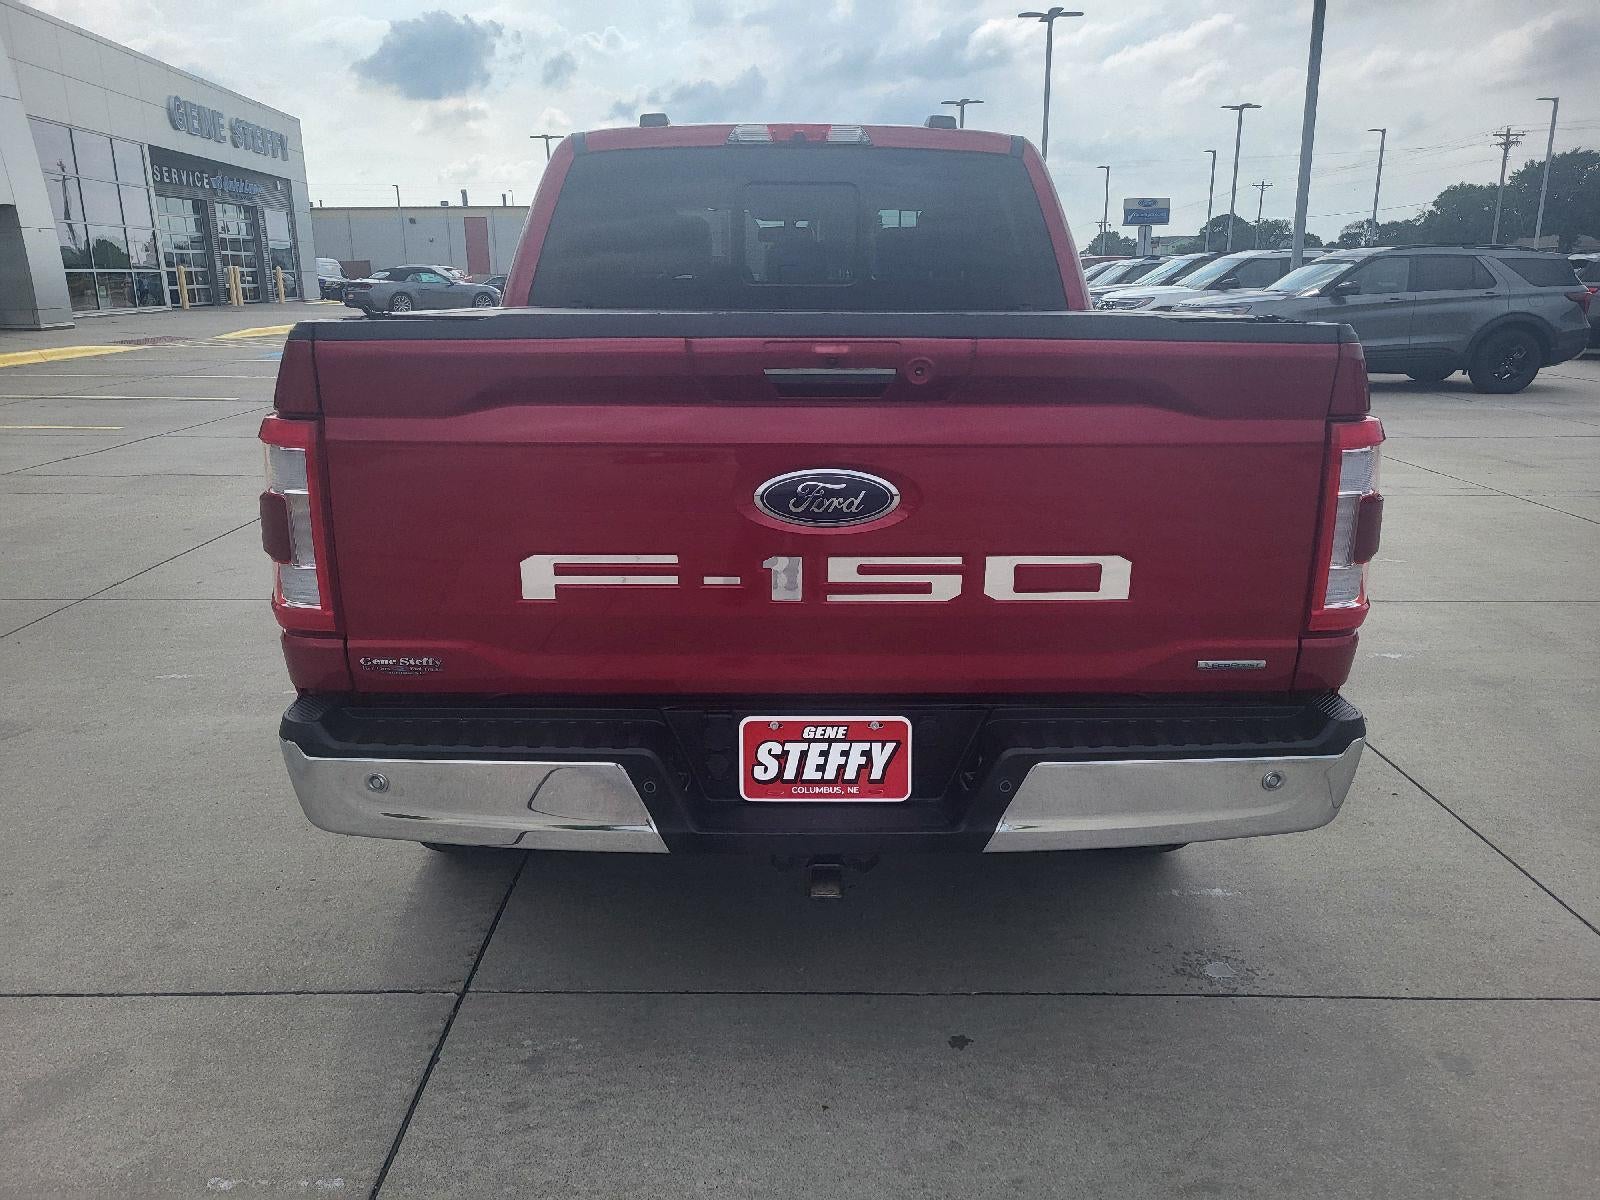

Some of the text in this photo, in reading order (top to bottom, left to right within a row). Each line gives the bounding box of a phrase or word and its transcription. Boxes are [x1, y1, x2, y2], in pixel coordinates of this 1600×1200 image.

[167, 95, 288, 161] GENE STEFFY
[153, 165, 210, 189] SERVICE
[789, 481, 867, 513] Ford
[519, 554, 1133, 603] F-150
[359, 657, 442, 668] Gene Steffy
[803, 725, 848, 739] GENE
[753, 741, 897, 780] STEFFY
[791, 786, 860, 795] COLUMBUS, NE
